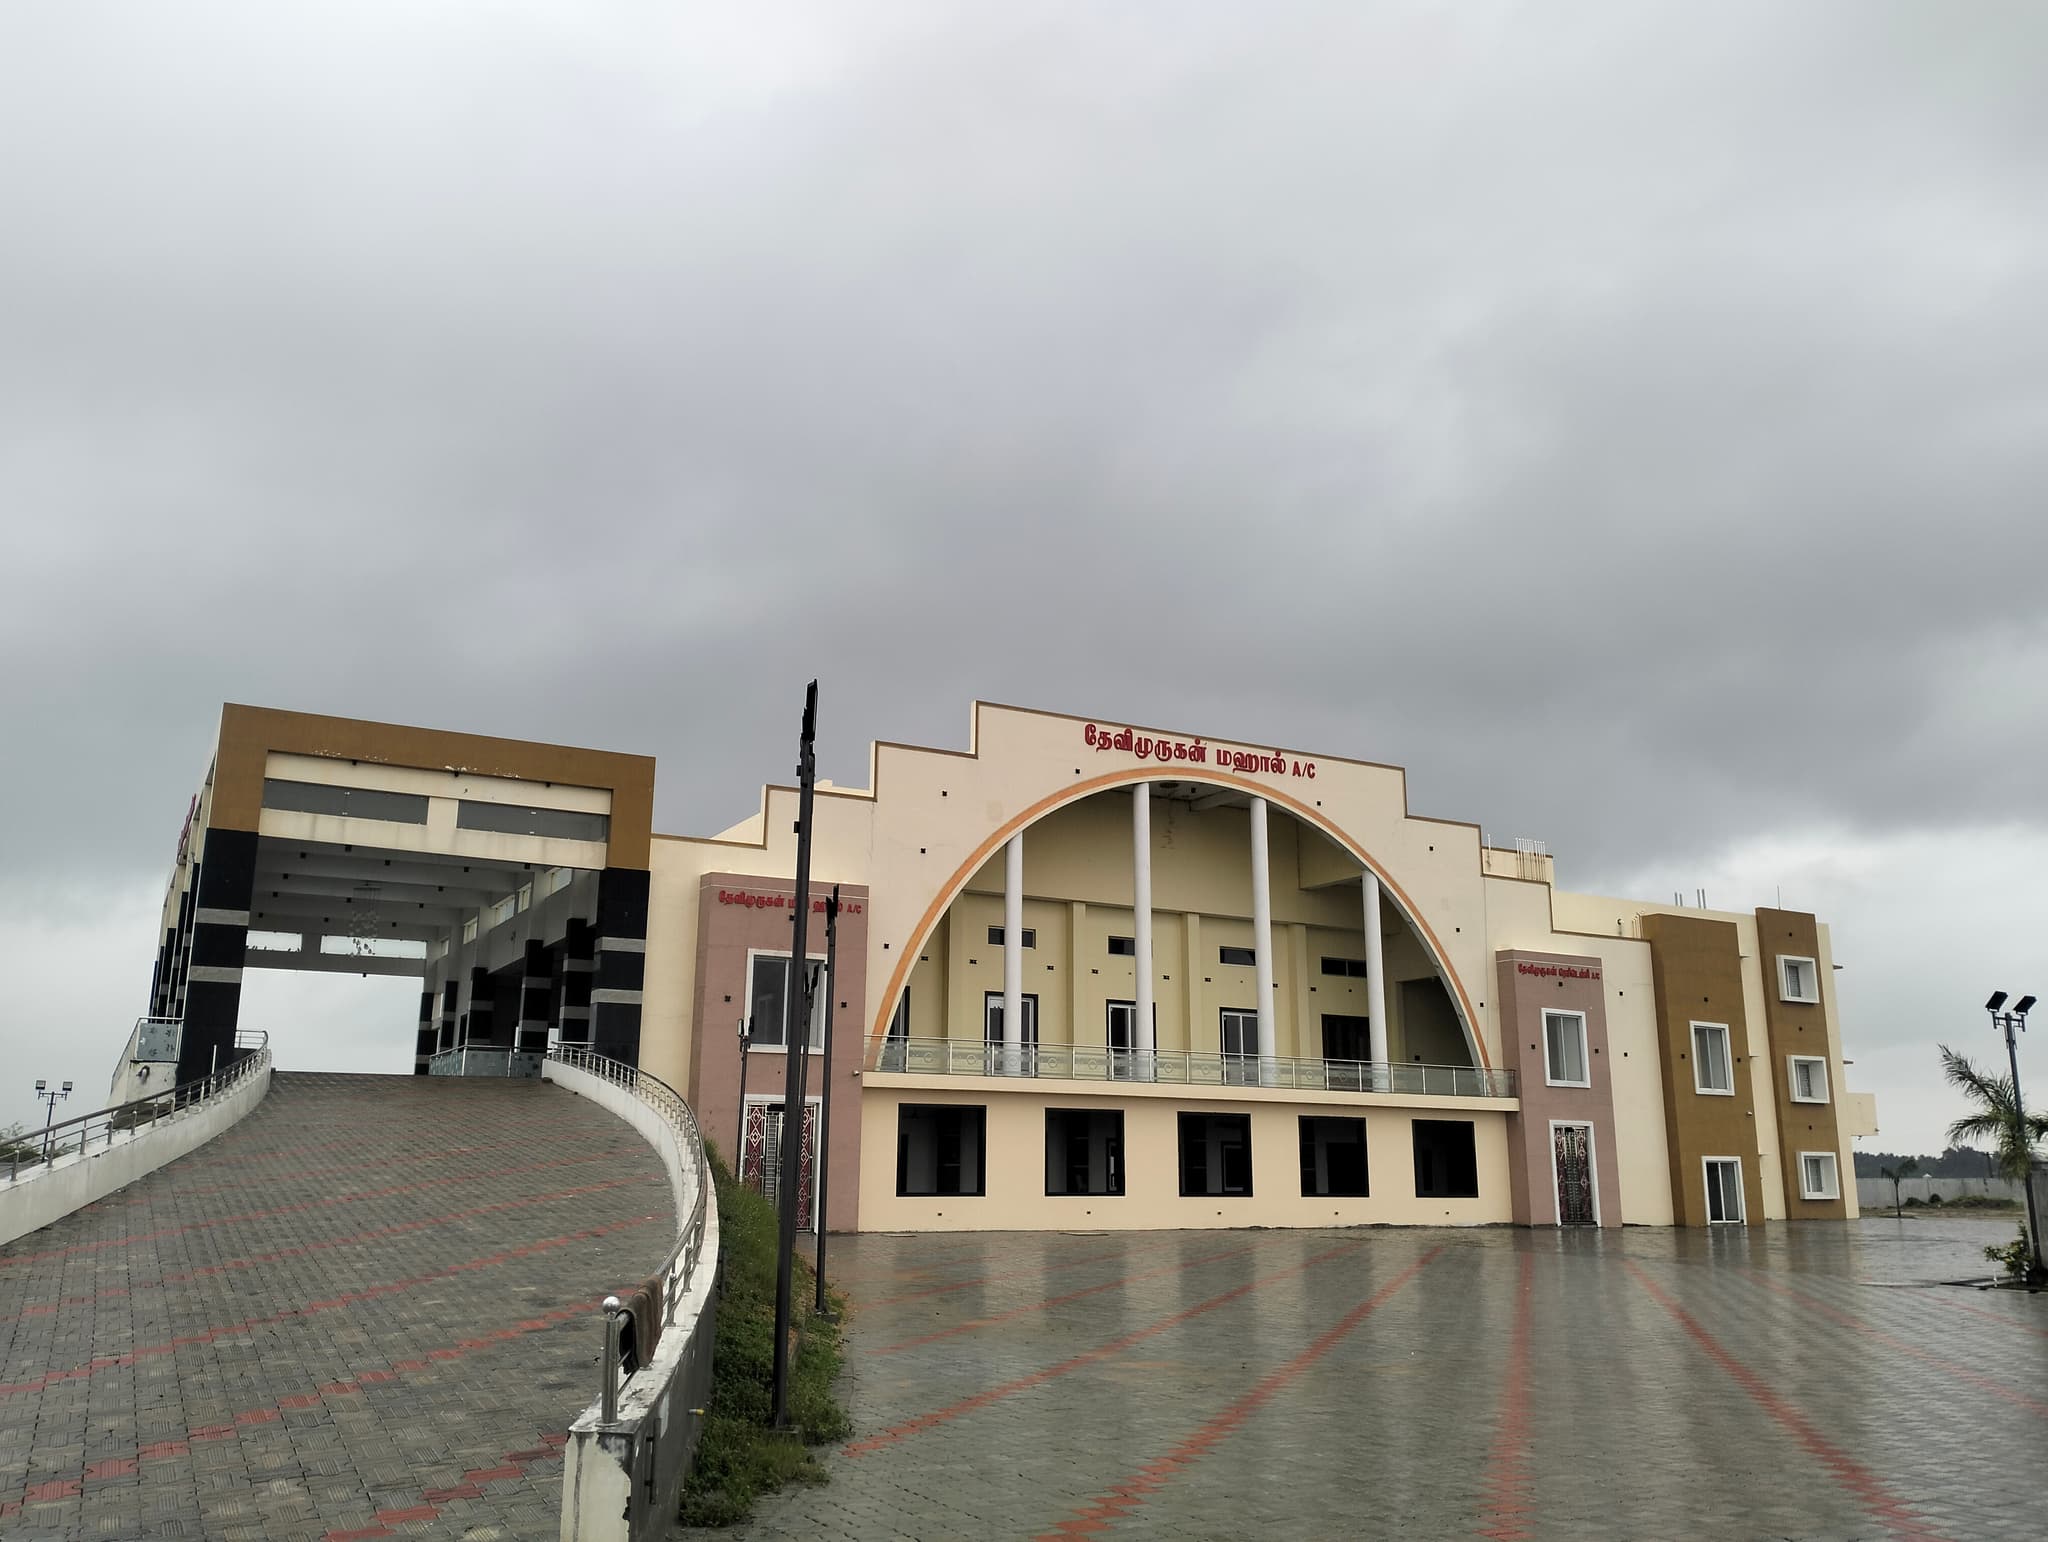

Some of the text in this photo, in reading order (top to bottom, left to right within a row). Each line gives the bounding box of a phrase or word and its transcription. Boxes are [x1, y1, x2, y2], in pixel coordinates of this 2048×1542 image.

[1084, 723, 1316, 779] தேவிமுருகன் மஹால் A/C
[718, 890, 784, 909] தேவிமுருகன்
[847, 905, 862, 915] A/C
